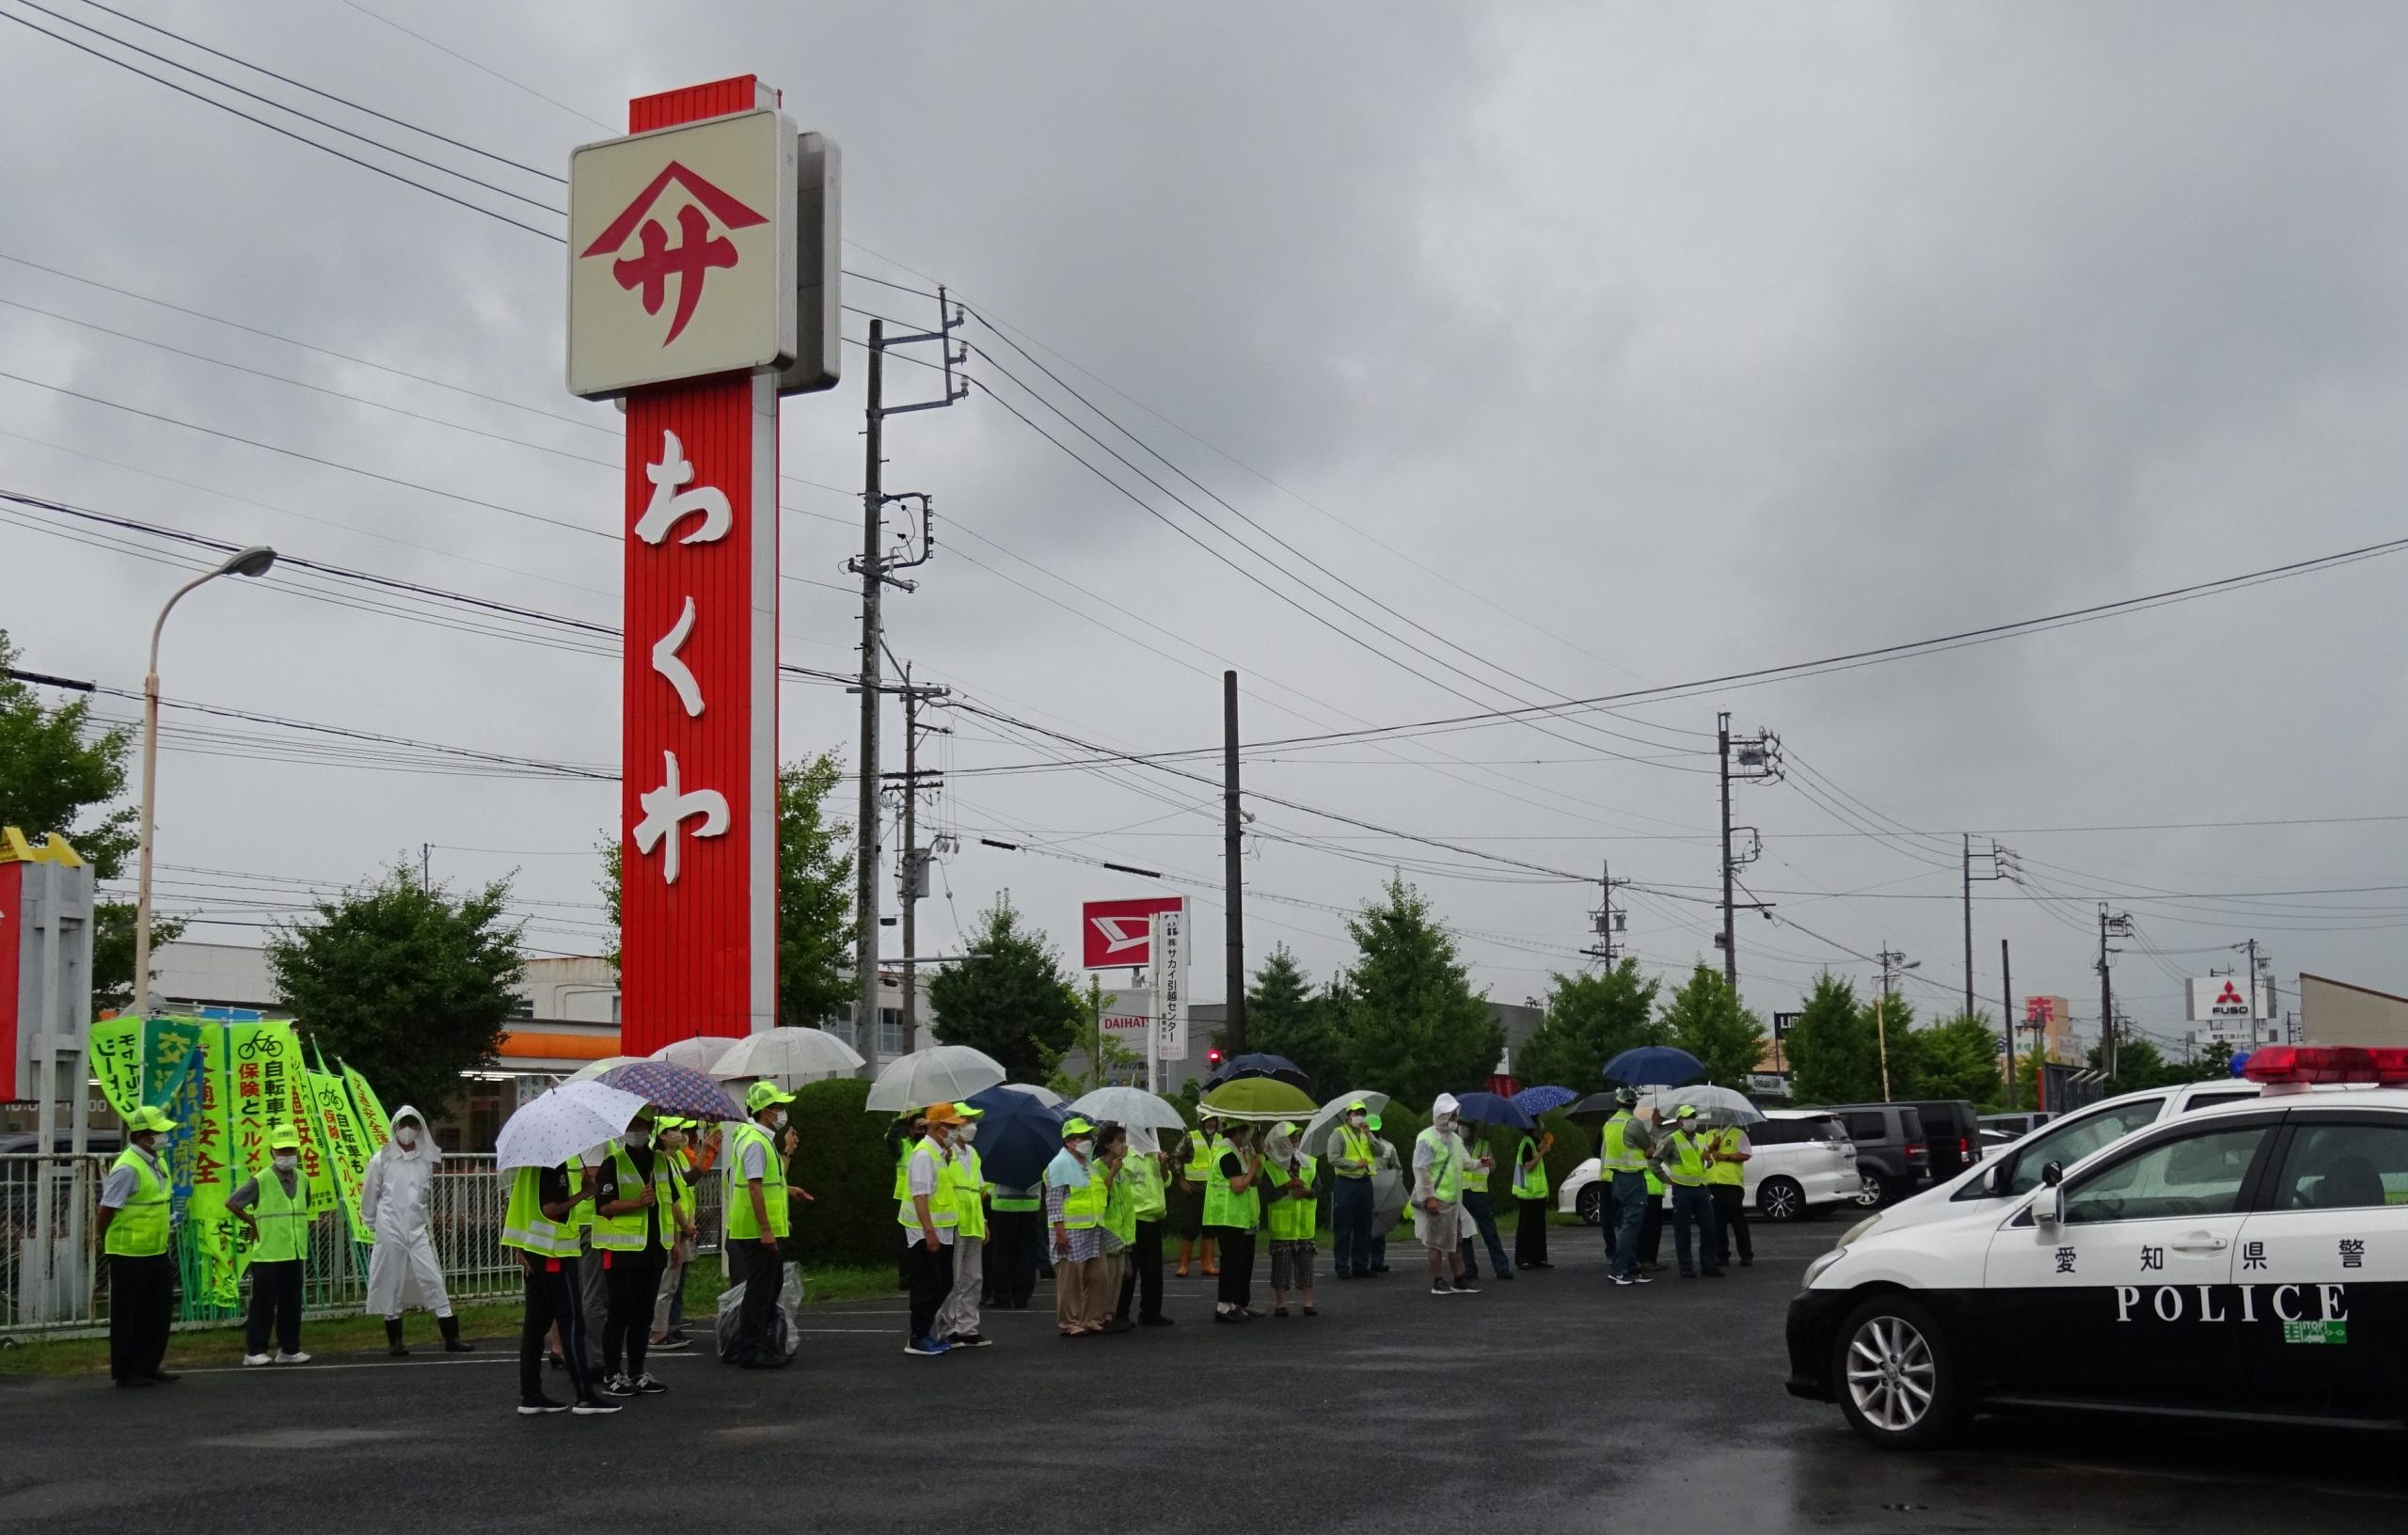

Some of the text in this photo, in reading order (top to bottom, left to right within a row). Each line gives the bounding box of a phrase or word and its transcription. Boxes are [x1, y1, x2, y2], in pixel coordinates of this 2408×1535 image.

[633, 429, 733, 885] ちくわ
[1104, 1017, 1149, 1030] DAIHAT
[336, 1114, 365, 1175] 自転車も
[2055, 1239, 2365, 1274] 愛知県警
[2115, 1283, 2349, 1322] POLICE
